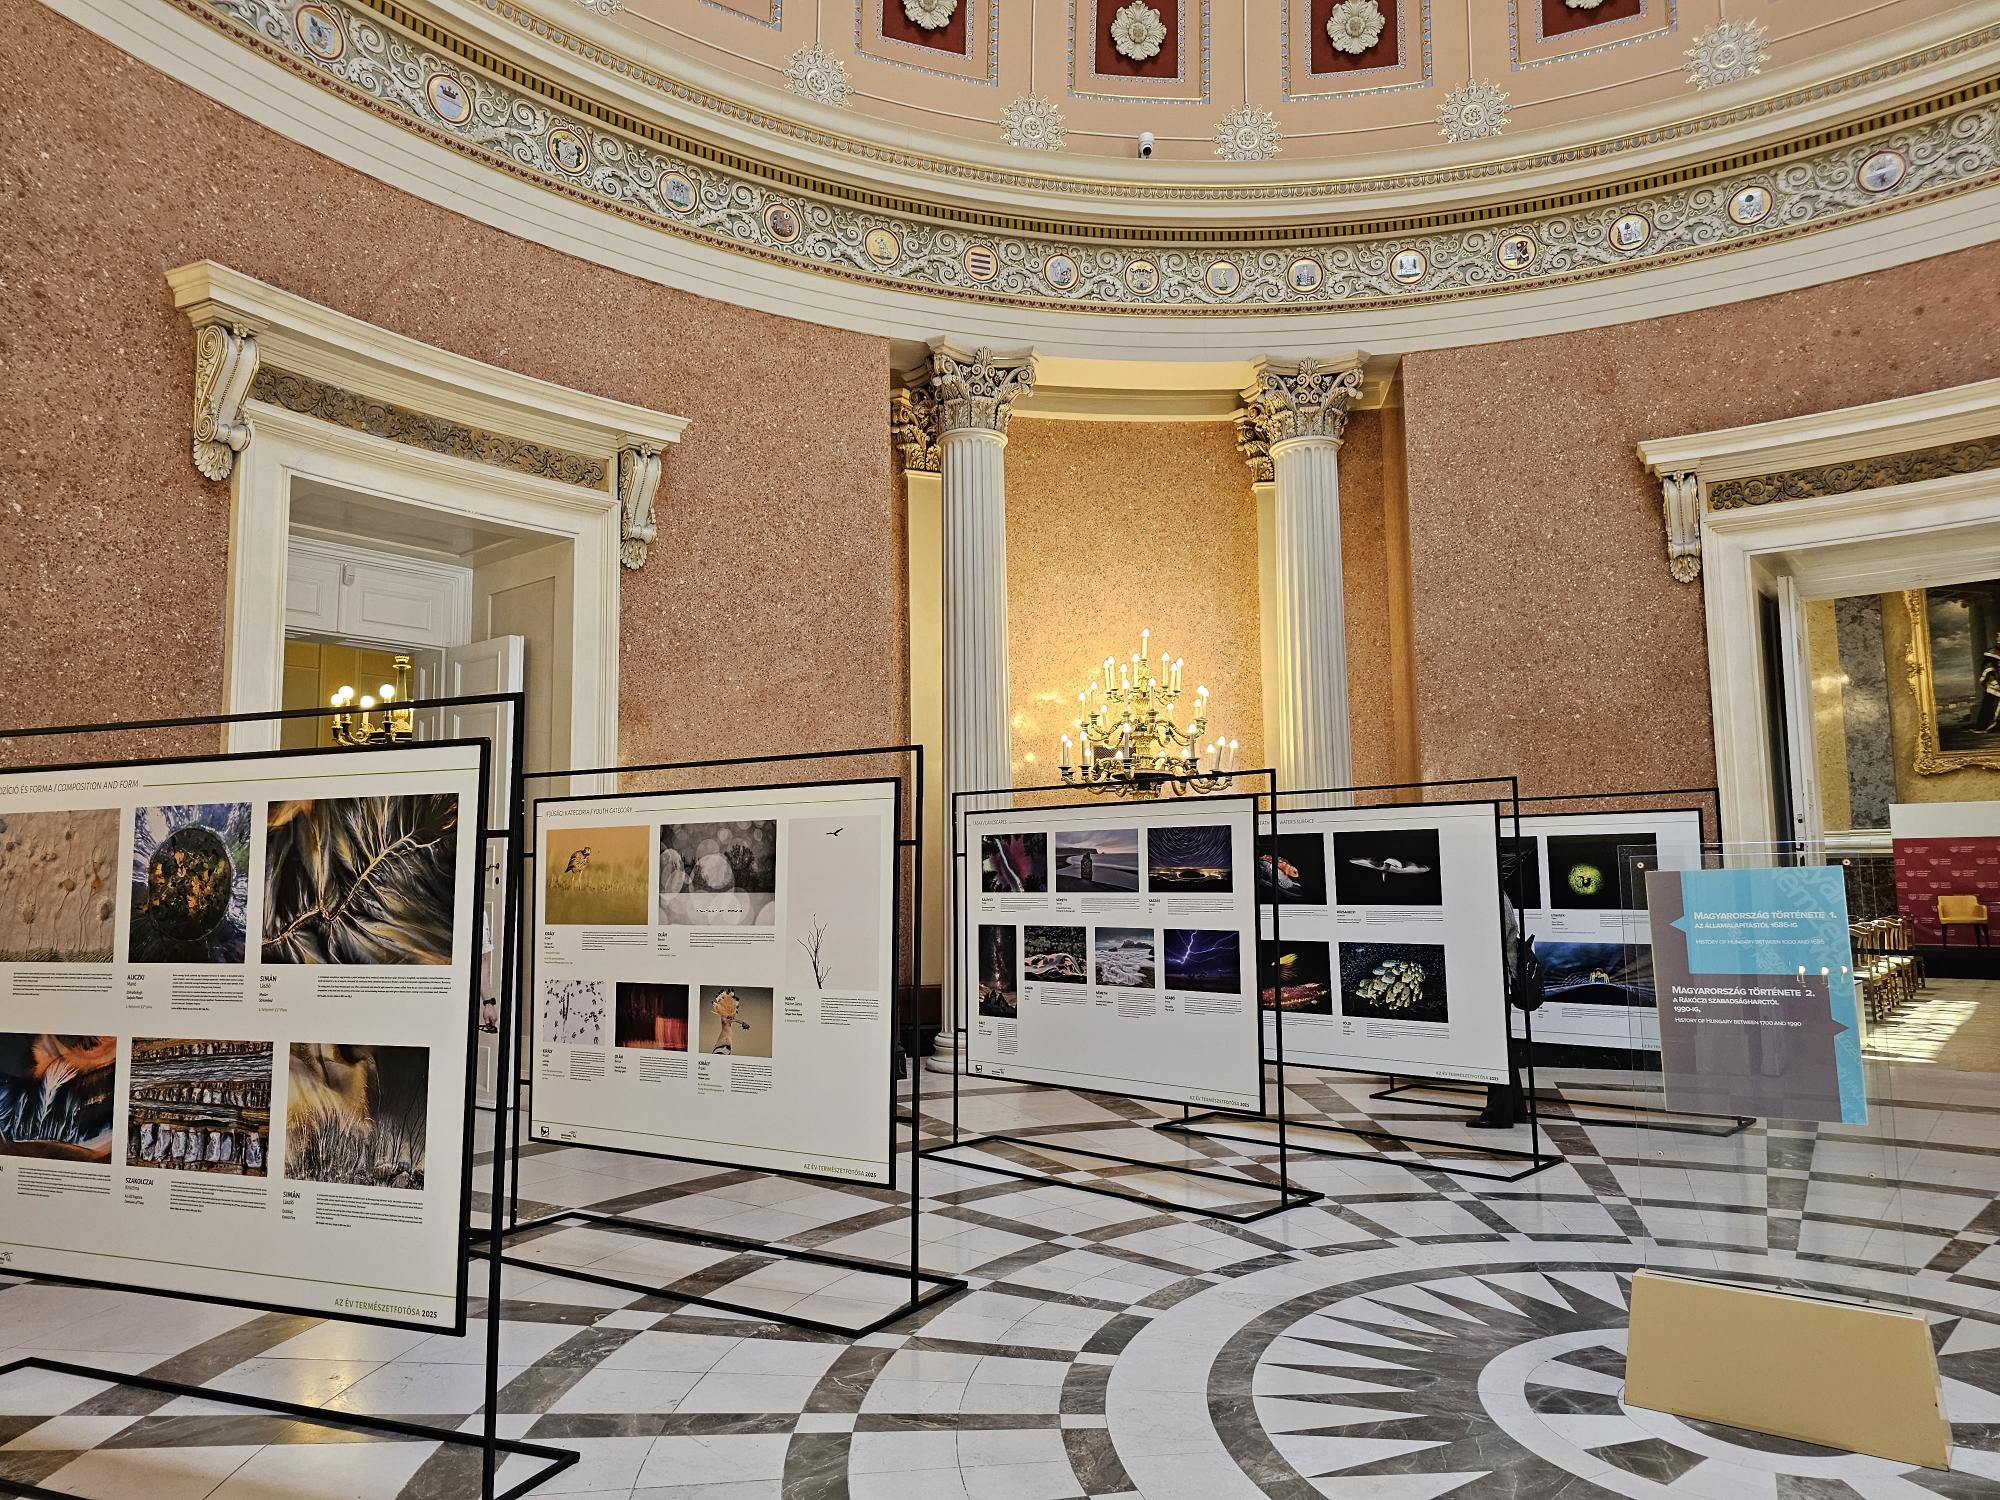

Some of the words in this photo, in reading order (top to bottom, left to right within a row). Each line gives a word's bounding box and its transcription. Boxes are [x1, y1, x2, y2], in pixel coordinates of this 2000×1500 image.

[29, 784, 52, 794] FORMA
[58, 781, 102, 792] COMPOSITION
[103, 780, 118, 790] AND
[120, 780, 138, 788] FORM
[1694, 910, 1770, 920] MAGYARORSZÁG
[1771, 910, 1825, 919] TÖRTÉNETE
[1672, 986, 1747, 996] MAGYARORSZÁG
[1748, 987, 1801, 997] TÖRTÉNETE
[1708, 997, 1780, 1006] SZABADSÁGHARCTÓL
[282, 1190, 301, 1198] SIMÁN
[334, 1298, 344, 1306] AZ
[345, 1298, 354, 1308] ÉV
[355, 1301, 421, 1317] TERMÉSZETFOTÓSA
[421, 1310, 438, 1319] 2025
